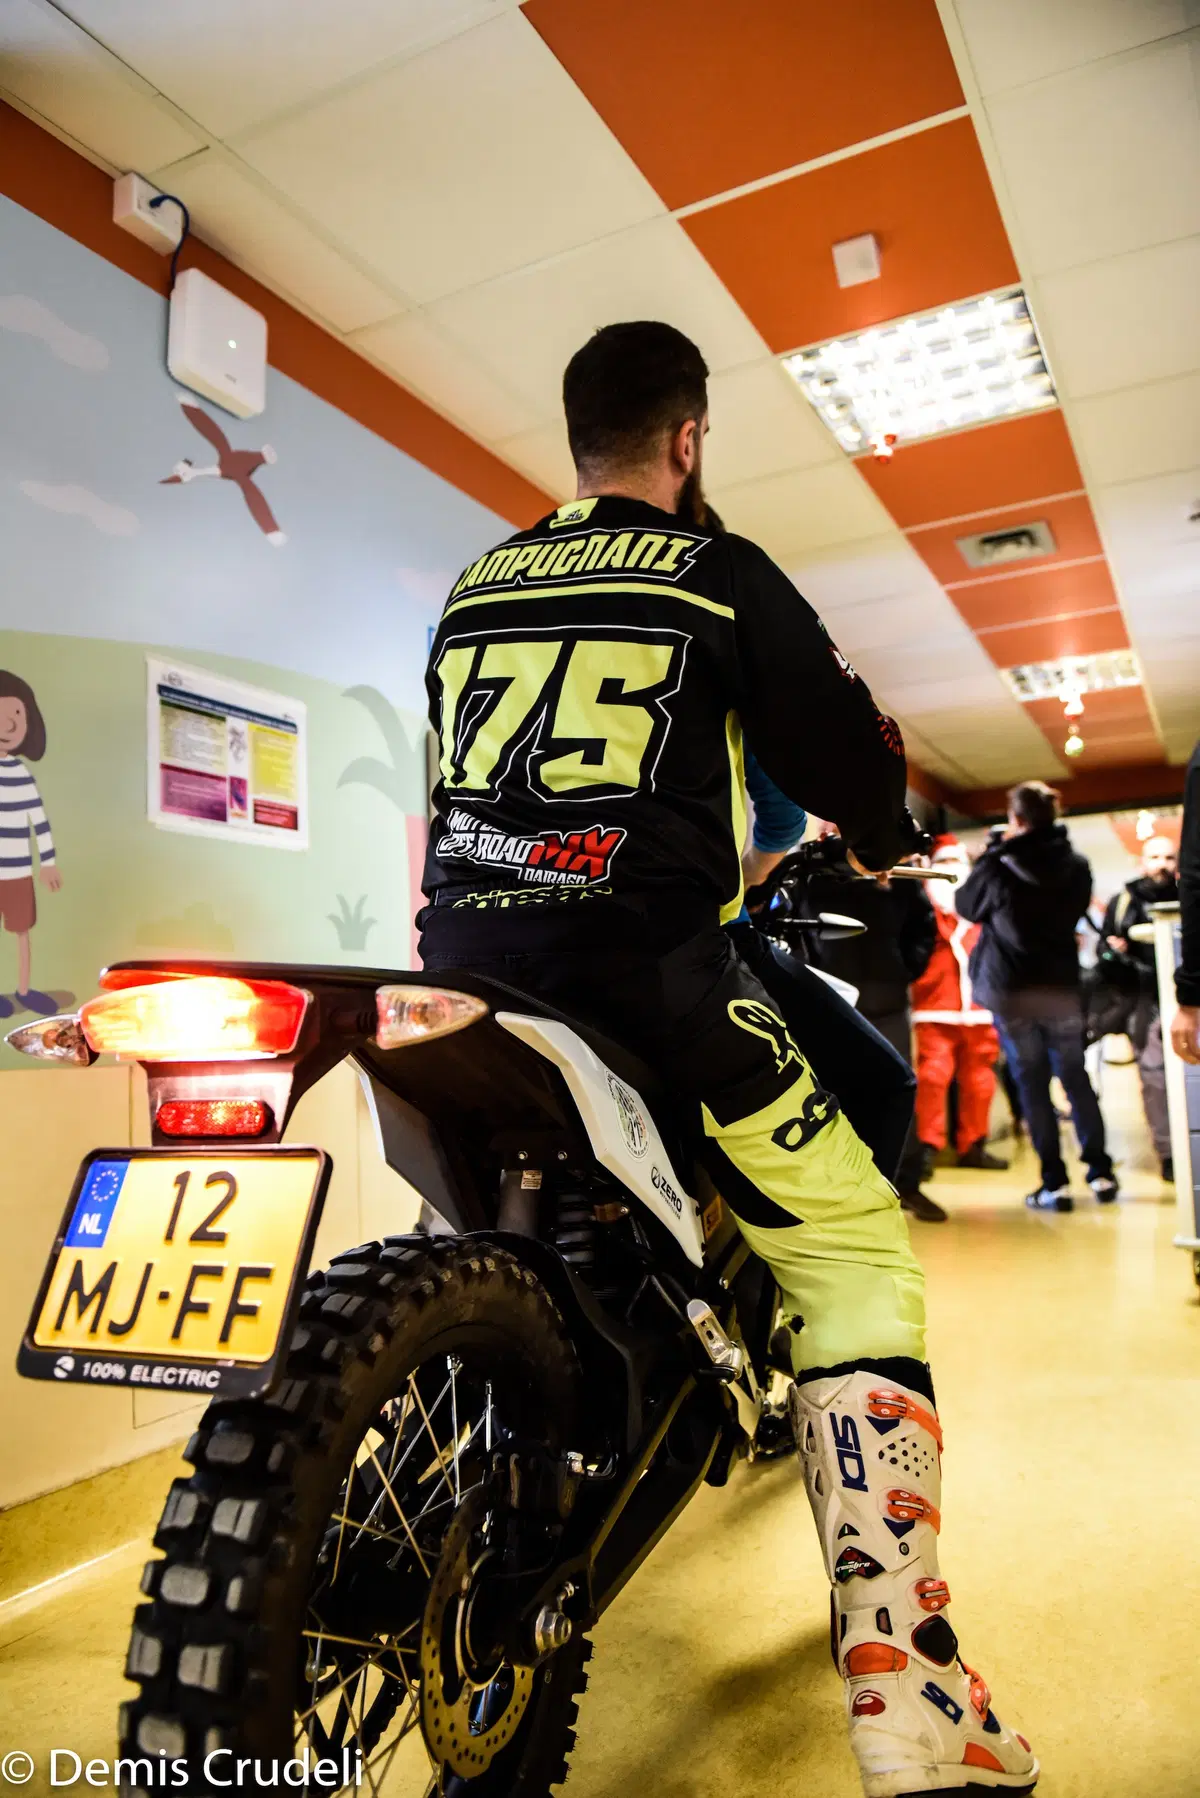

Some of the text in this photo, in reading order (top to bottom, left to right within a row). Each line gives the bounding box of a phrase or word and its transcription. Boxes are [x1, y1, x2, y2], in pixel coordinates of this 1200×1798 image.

[438, 641, 674, 792] 175
[474, 833, 545, 864] ROAD
[527, 829, 621, 878] MX
[164, 1170, 237, 1242] 12
[661, 1176, 682, 1213] ZERO
[78, 1213, 102, 1235] NL
[82, 1361, 222, 1389] 100% ELECTRIC
[829, 1412, 869, 1493] SIDI
